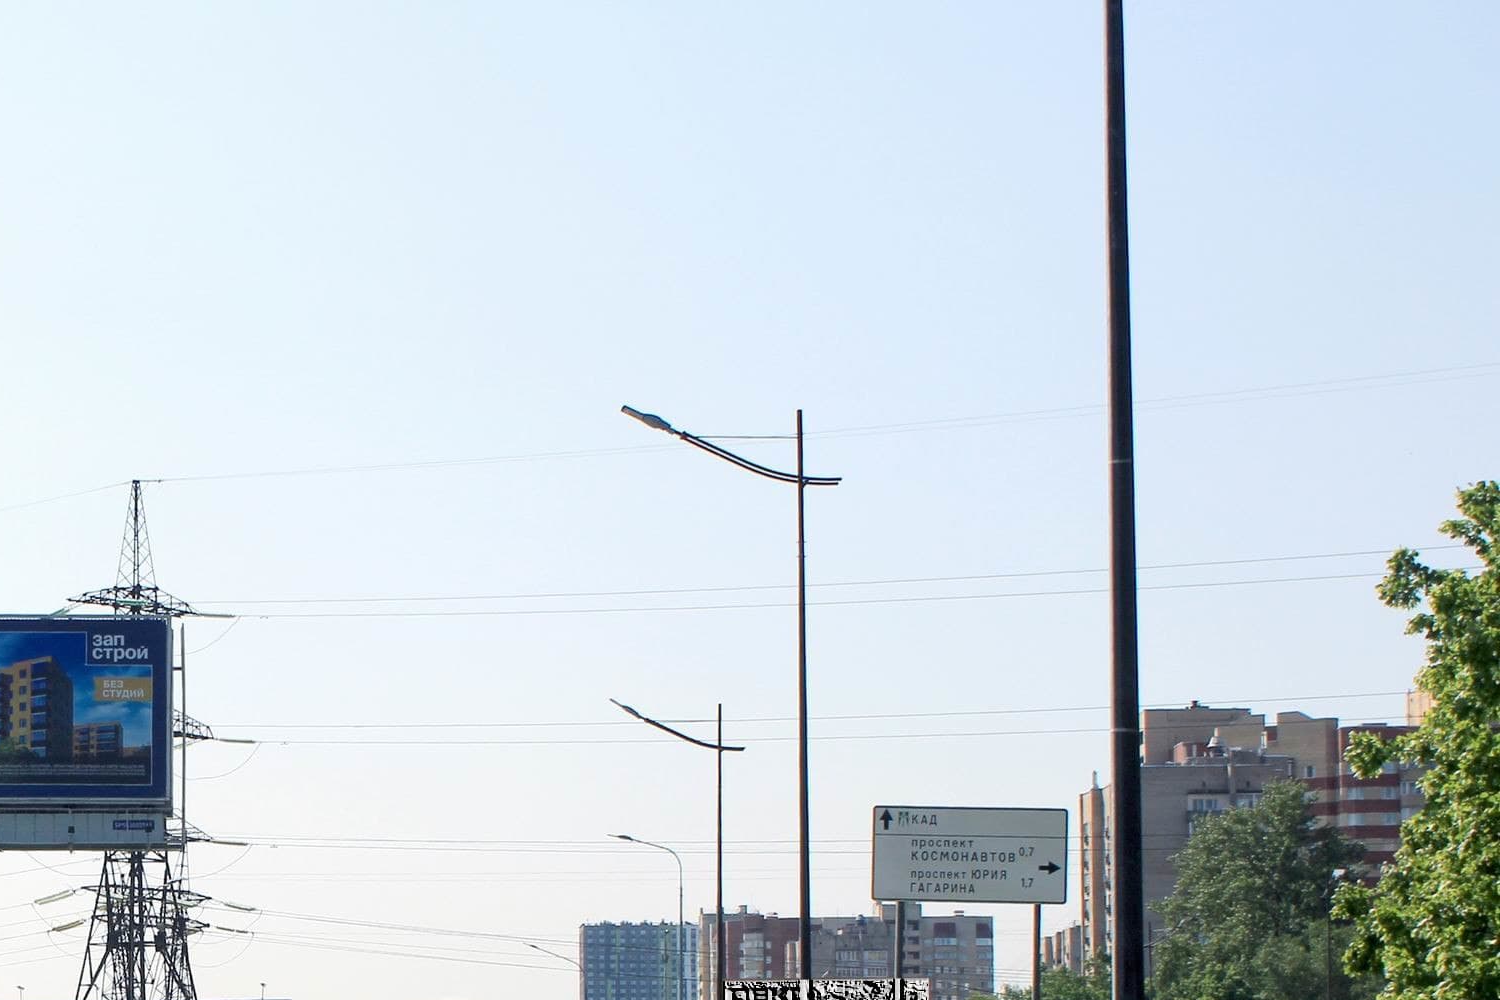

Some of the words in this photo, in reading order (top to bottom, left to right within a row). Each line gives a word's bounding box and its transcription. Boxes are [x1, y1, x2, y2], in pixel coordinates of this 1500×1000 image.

[92, 634, 125, 647] зап
[92, 646, 149, 662] строй
[103, 680, 124, 688] БЕЗ
[102, 688, 144, 698] СТУДИЙ
[911, 814, 937, 826] КАД
[911, 839, 974, 849] проспект
[910, 850, 1016, 863] КОСМОНАВТОВ
[910, 870, 967, 880] проспект
[971, 869, 1008, 880] ЮРИЯ
[910, 882, 975, 893] ГАГАРИНА
